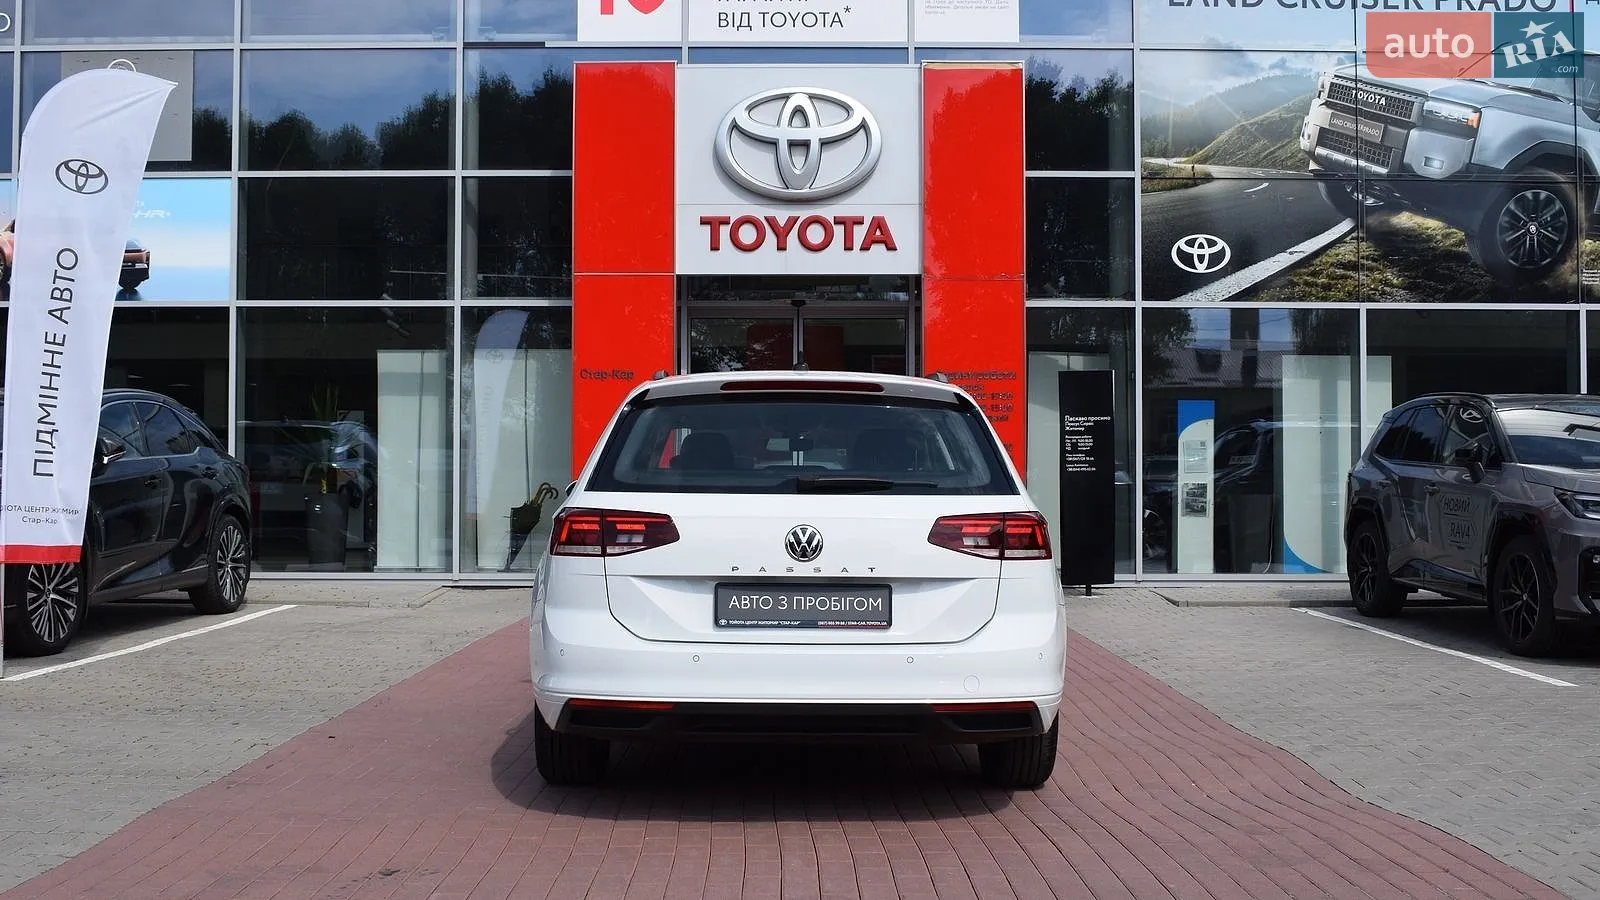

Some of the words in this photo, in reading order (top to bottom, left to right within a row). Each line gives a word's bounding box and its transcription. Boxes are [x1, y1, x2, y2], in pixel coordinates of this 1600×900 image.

[718, 12, 752, 31] ВІД
[1352, 90, 1386, 106] TOYOTA
[699, 215, 898, 252] TOYOTA
[47, 247, 79, 325] АВТО
[33, 331, 67, 477] ПІДМІННЕ
[24, 505, 50, 514] ЦЕНТР
[21, 516, 58, 525] Стар-Кар
[1450, 522, 1470, 538] RAV4
[728, 595, 773, 610] АВТО
[793, 596, 882, 611] ПРОБІГОМ
